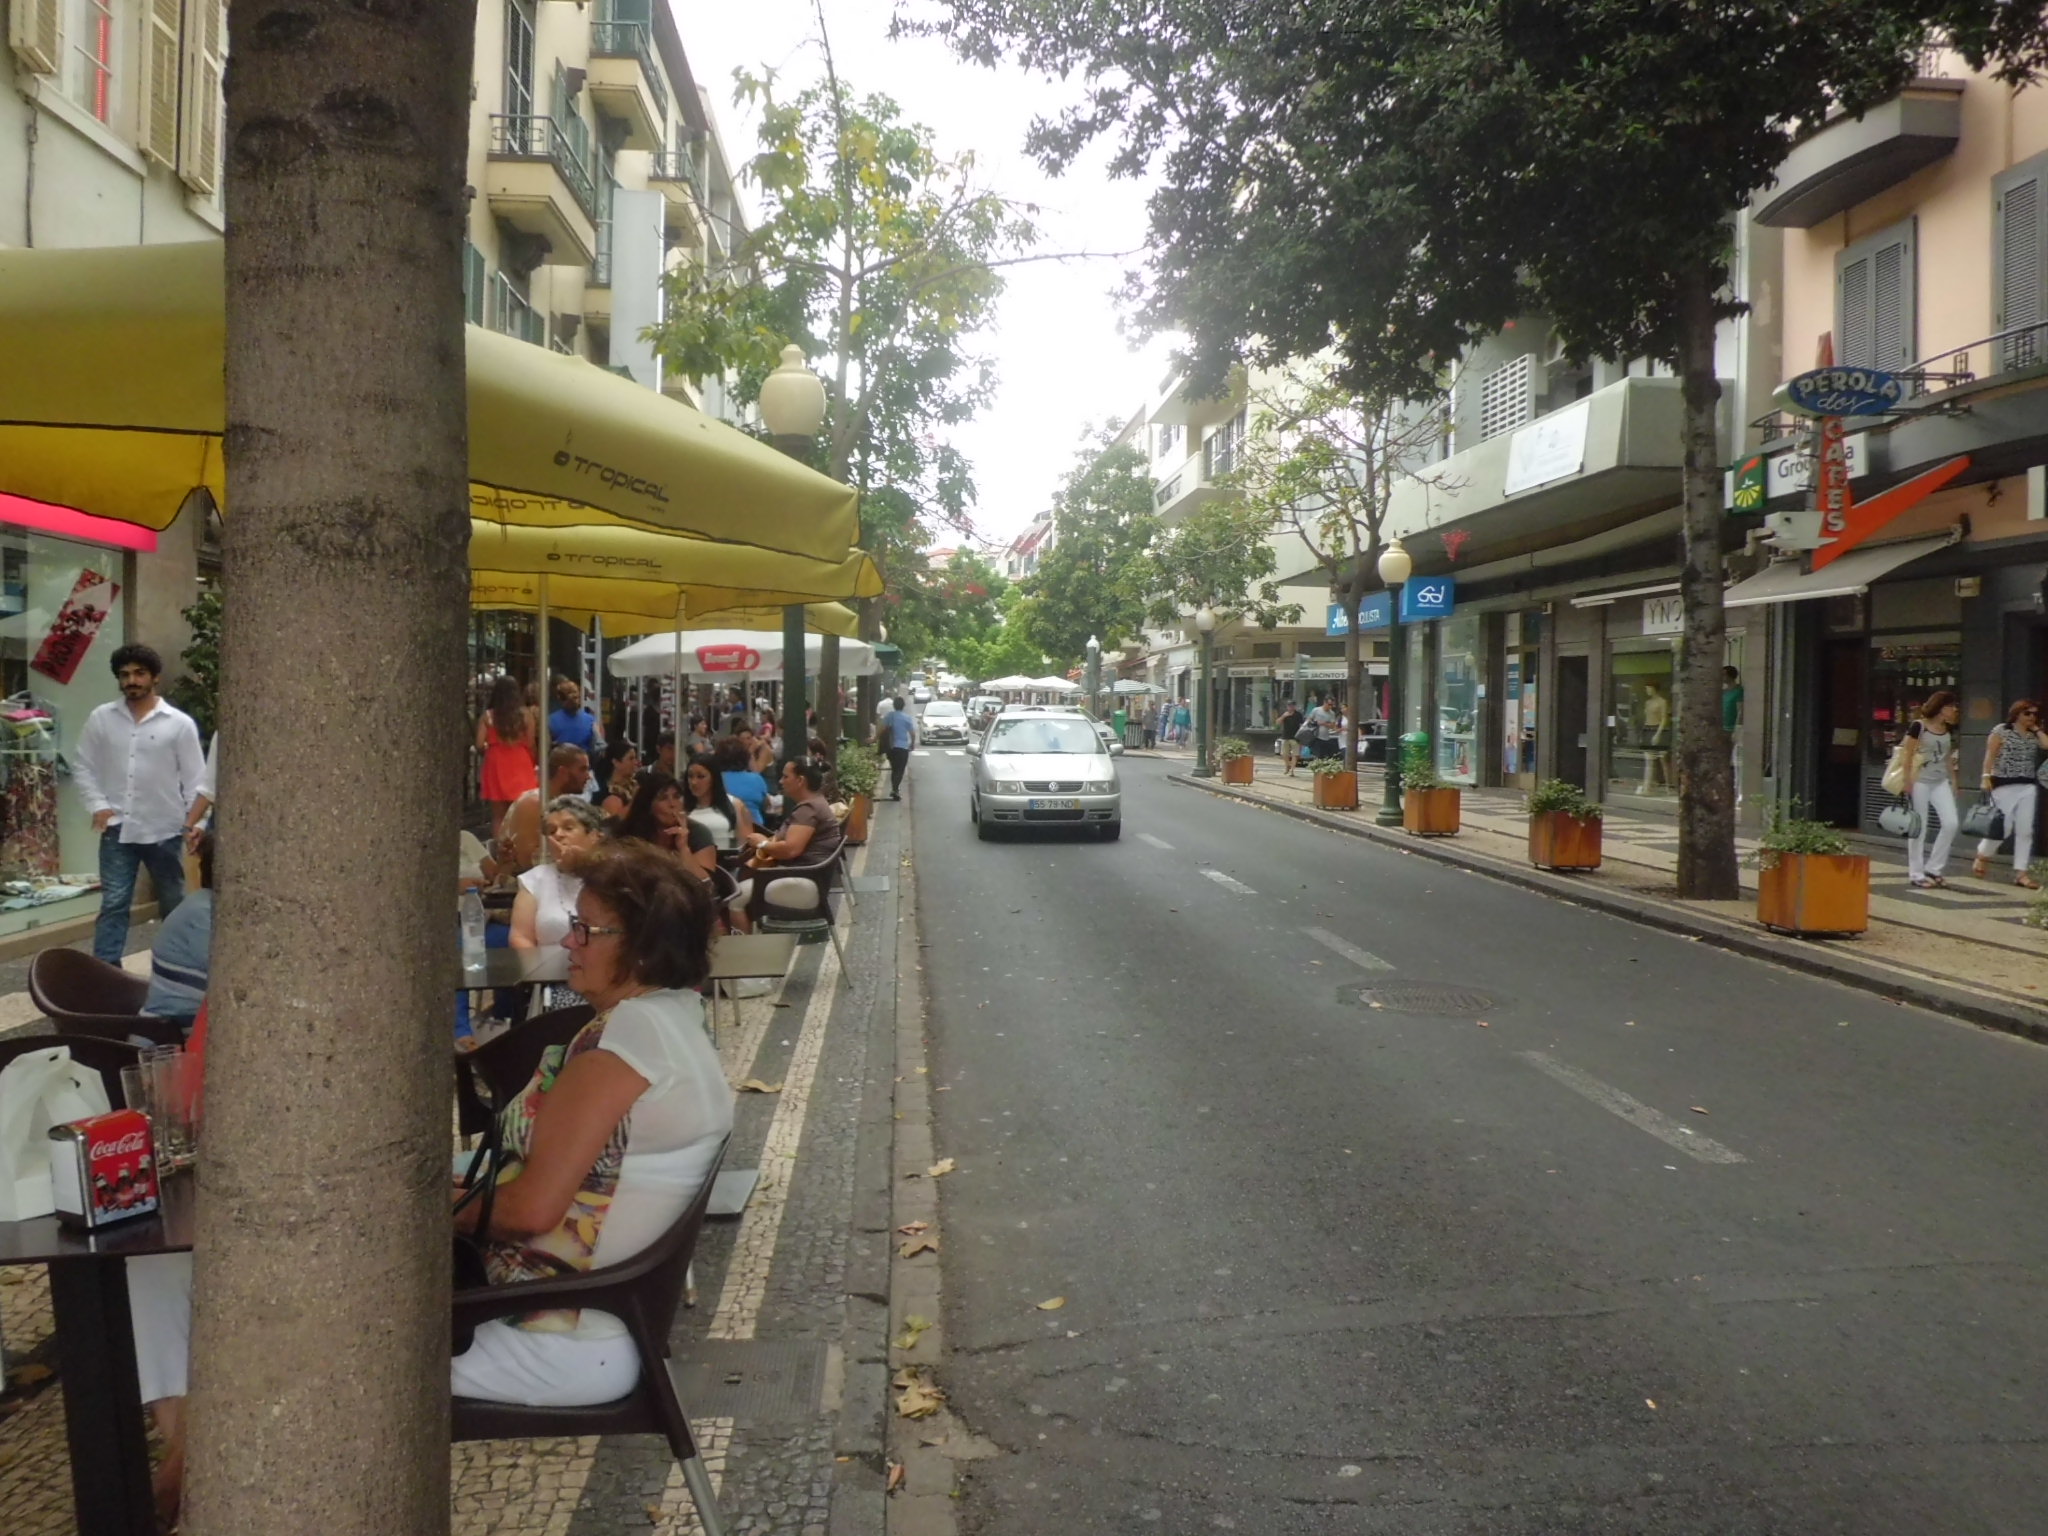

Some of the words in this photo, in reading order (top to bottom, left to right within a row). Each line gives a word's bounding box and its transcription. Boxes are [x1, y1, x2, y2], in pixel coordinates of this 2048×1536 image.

[1796, 370, 1899, 398] PÉROLA
[1817, 392, 1876, 412] dos
[90, 1131, 146, 1161] Coca-Cola
